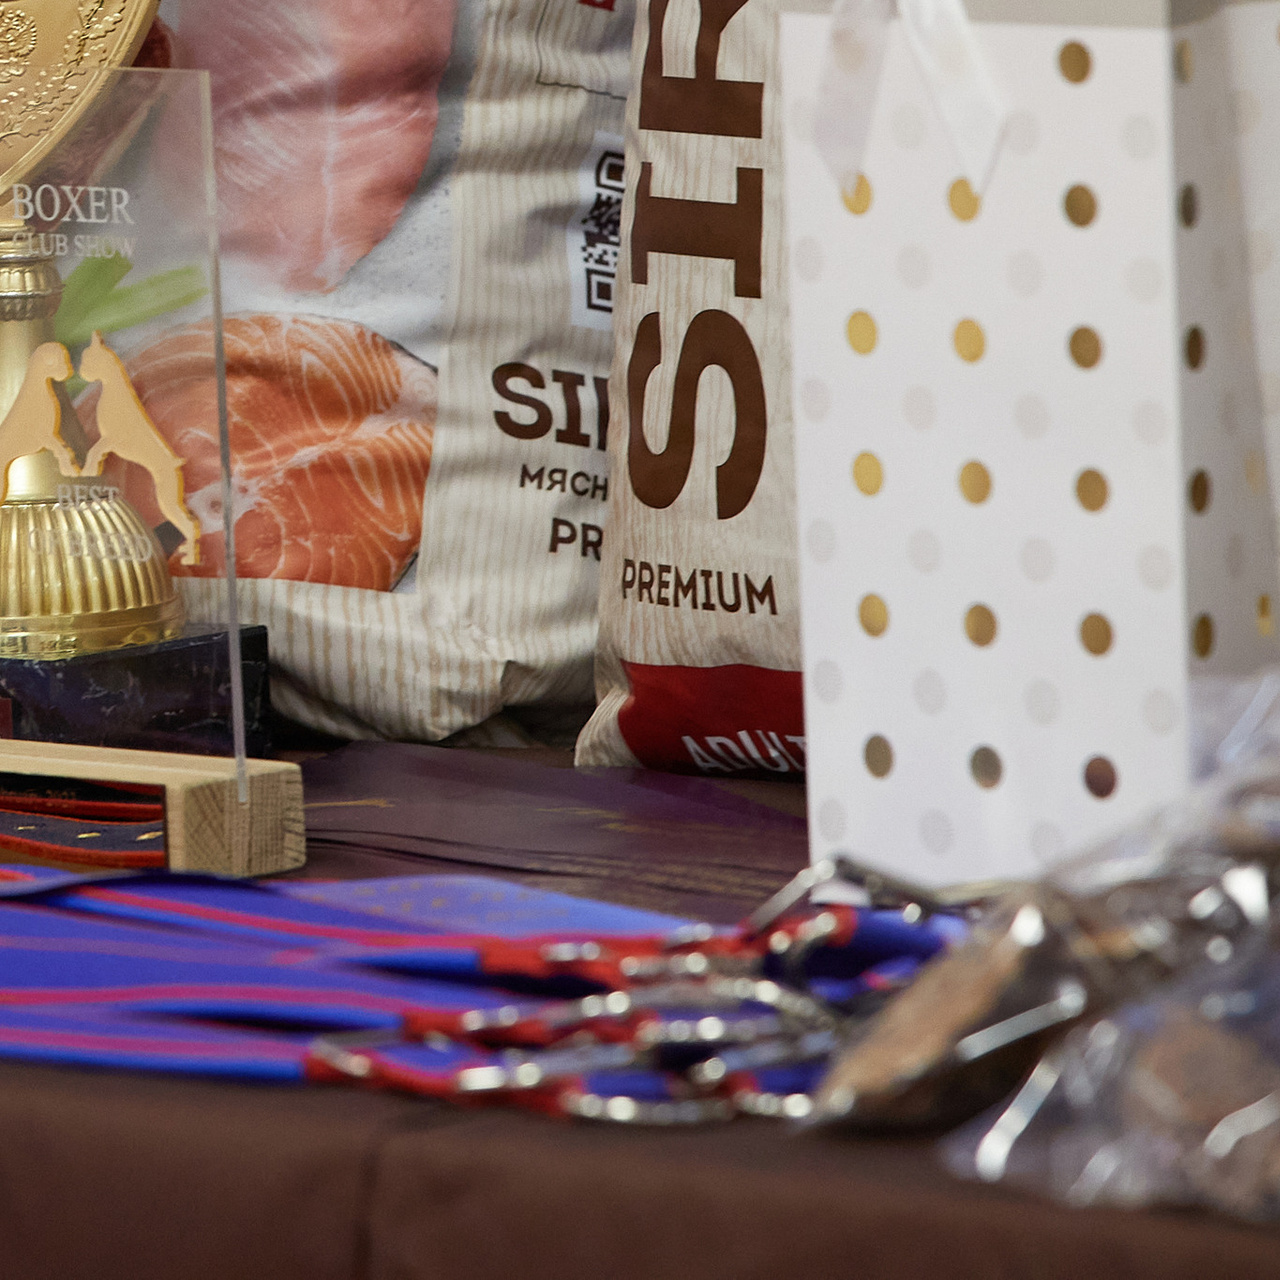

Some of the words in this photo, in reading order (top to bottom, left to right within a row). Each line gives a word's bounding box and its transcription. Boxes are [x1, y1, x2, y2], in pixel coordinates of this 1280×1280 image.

[12, 183, 136, 224] BOXER
[12, 231, 69, 257] CLUB
[74, 233, 138, 260] SHOW
[520, 464, 609, 502] МЯСН
[622, 558, 777, 615] PREMIUM
